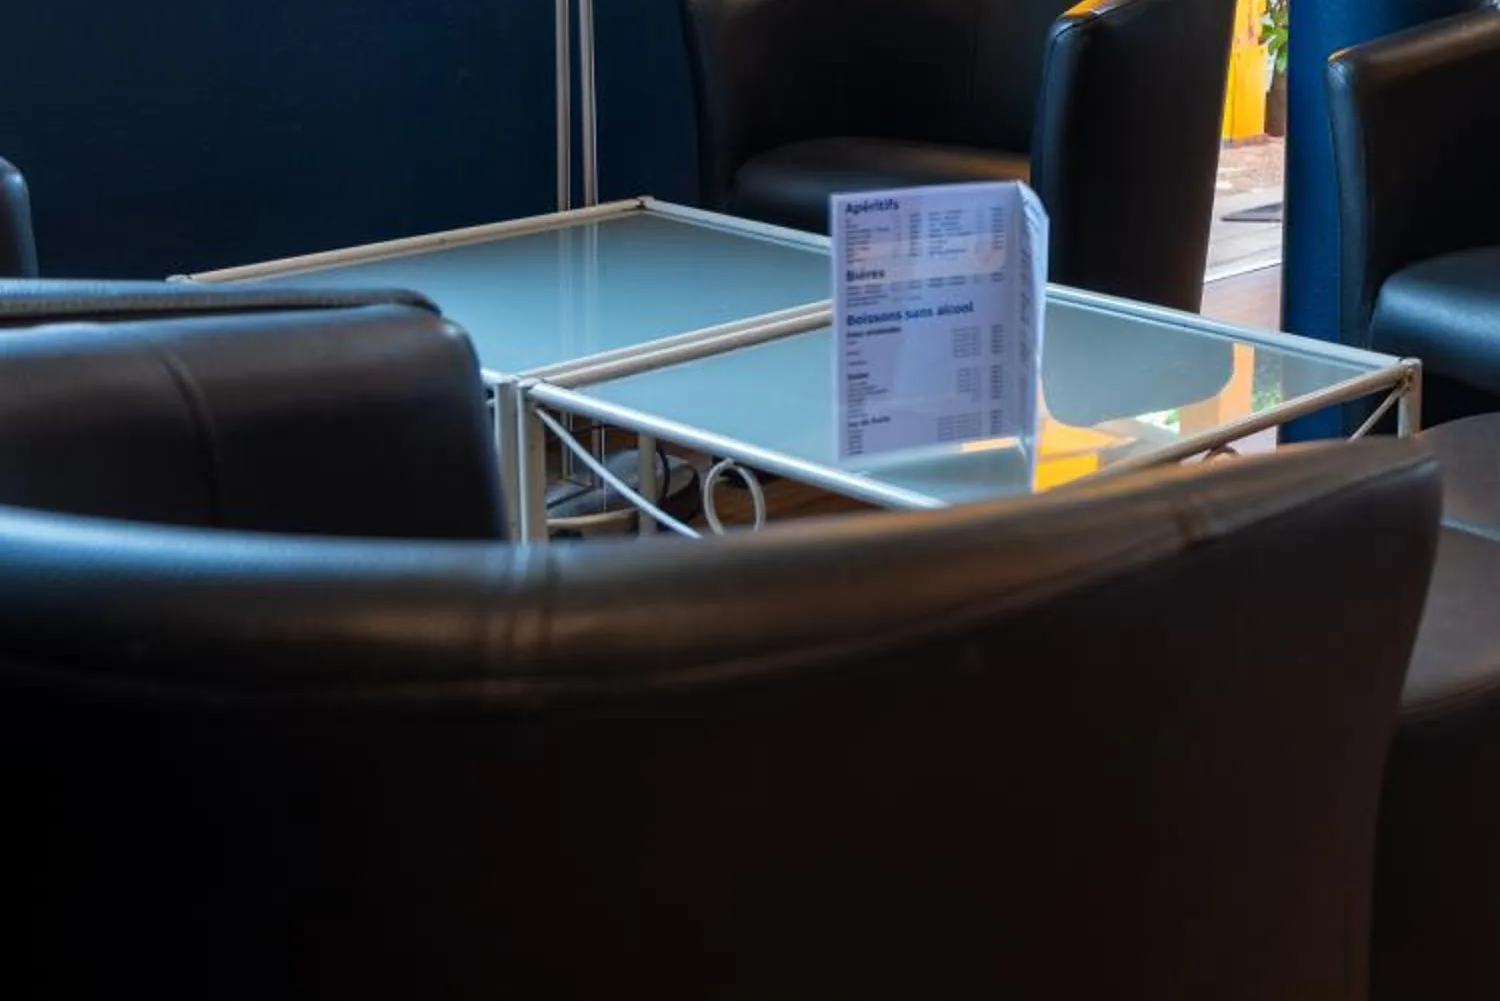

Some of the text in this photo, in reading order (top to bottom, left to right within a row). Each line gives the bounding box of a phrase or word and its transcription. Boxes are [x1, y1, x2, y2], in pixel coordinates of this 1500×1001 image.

[845, 199, 899, 216] Apéritifs
[847, 311, 901, 326] Boissons
[905, 307, 933, 320] sans
